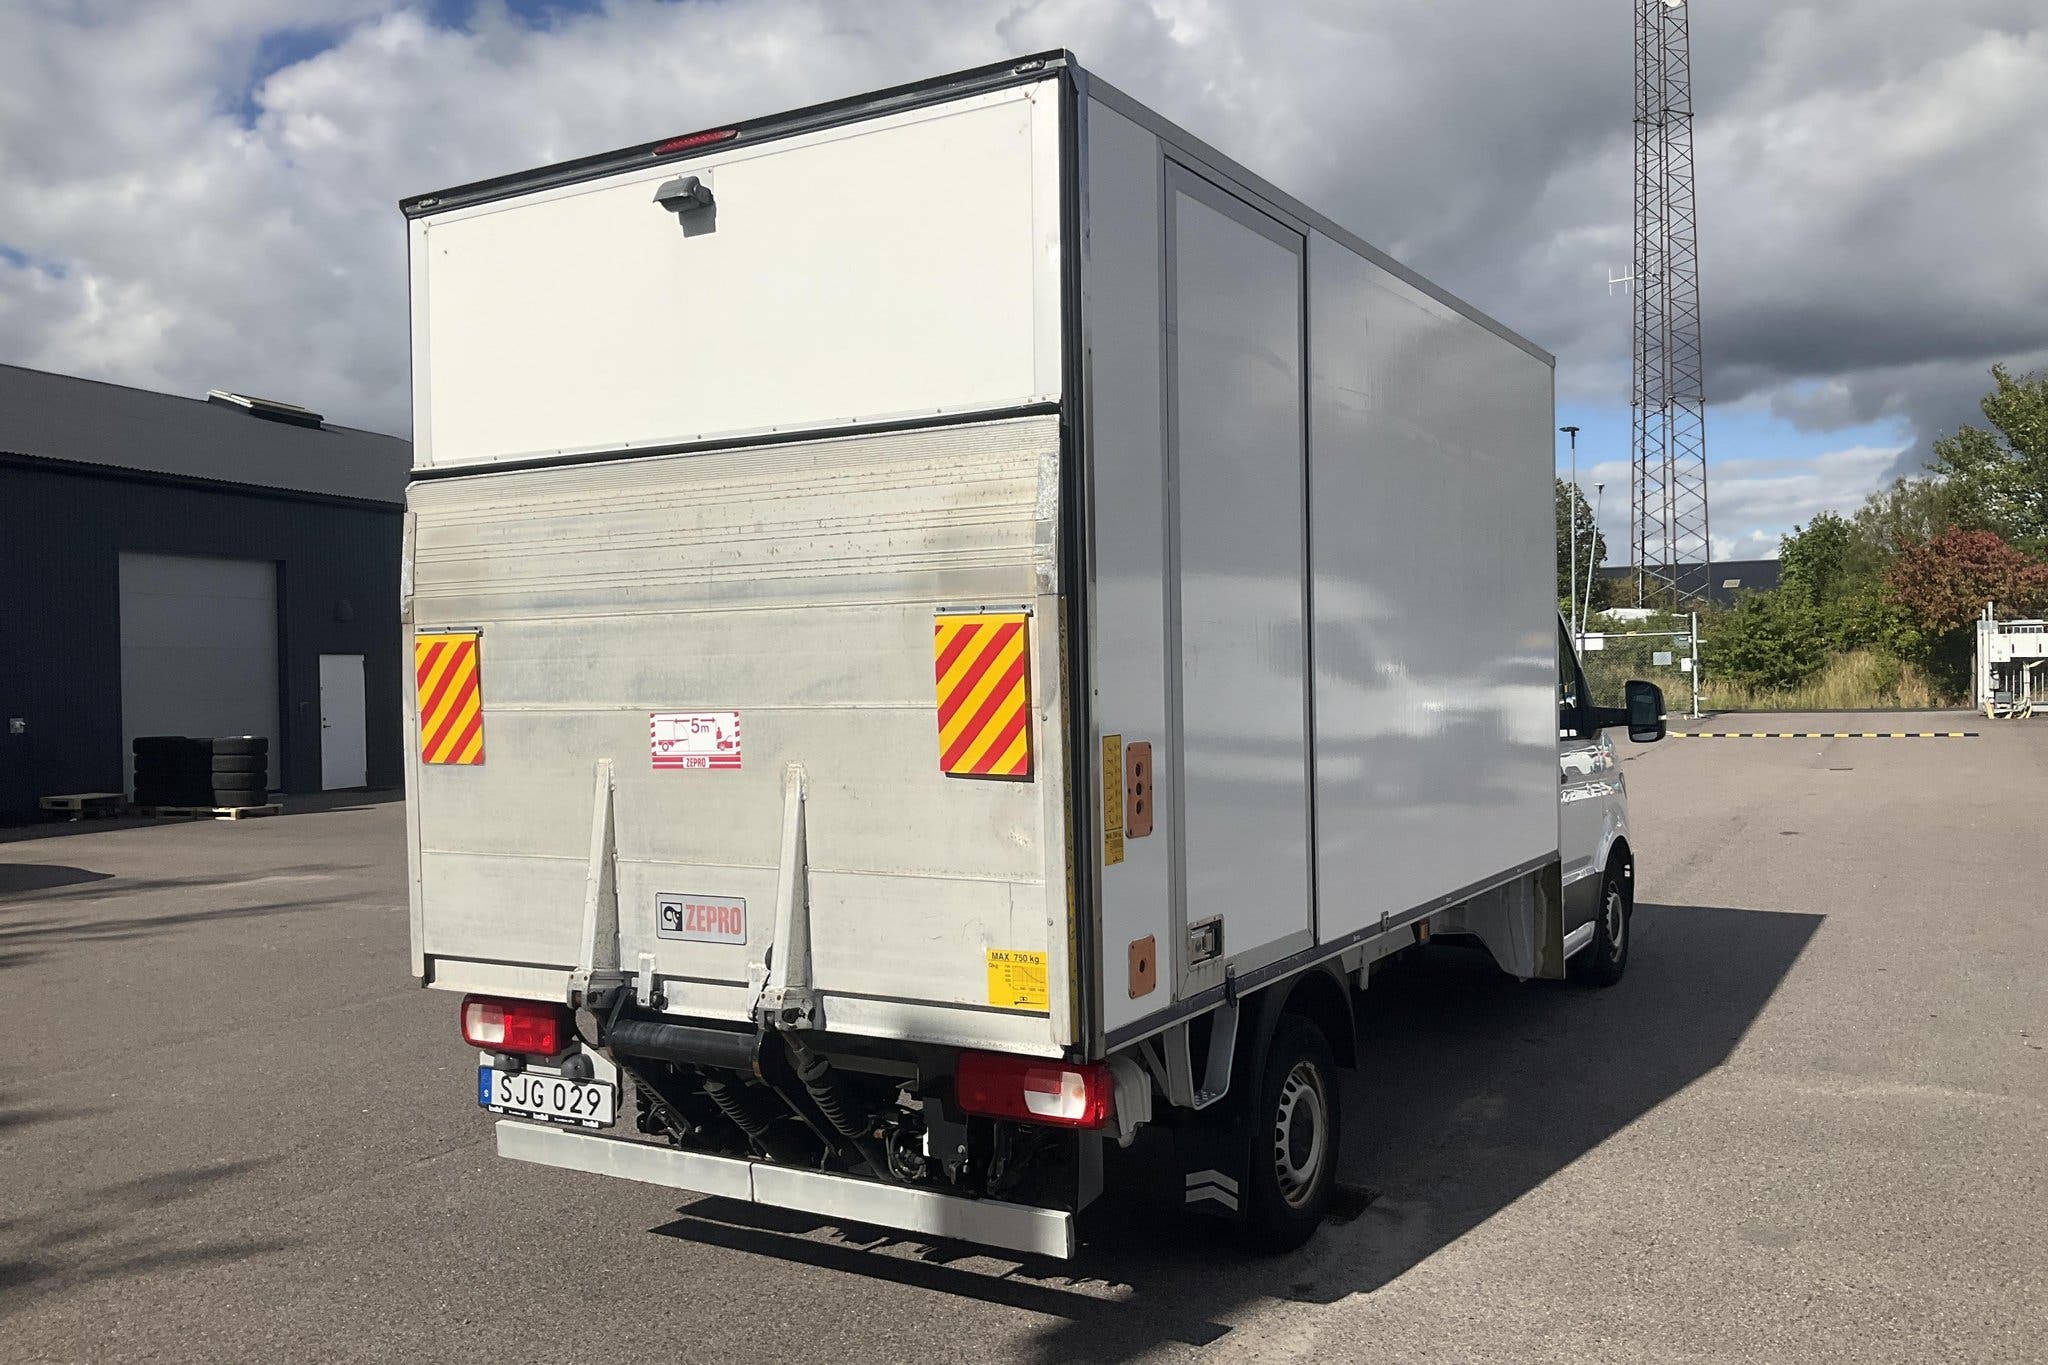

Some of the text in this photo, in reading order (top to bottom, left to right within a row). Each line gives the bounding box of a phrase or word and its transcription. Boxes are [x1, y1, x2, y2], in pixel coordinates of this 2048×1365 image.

[686, 757, 706, 768] ZEPRO
[685, 903, 742, 936] ZEPRO
[991, 952, 1040, 965] MAX 750 kg
[501, 1076, 601, 1116] SJG 029
